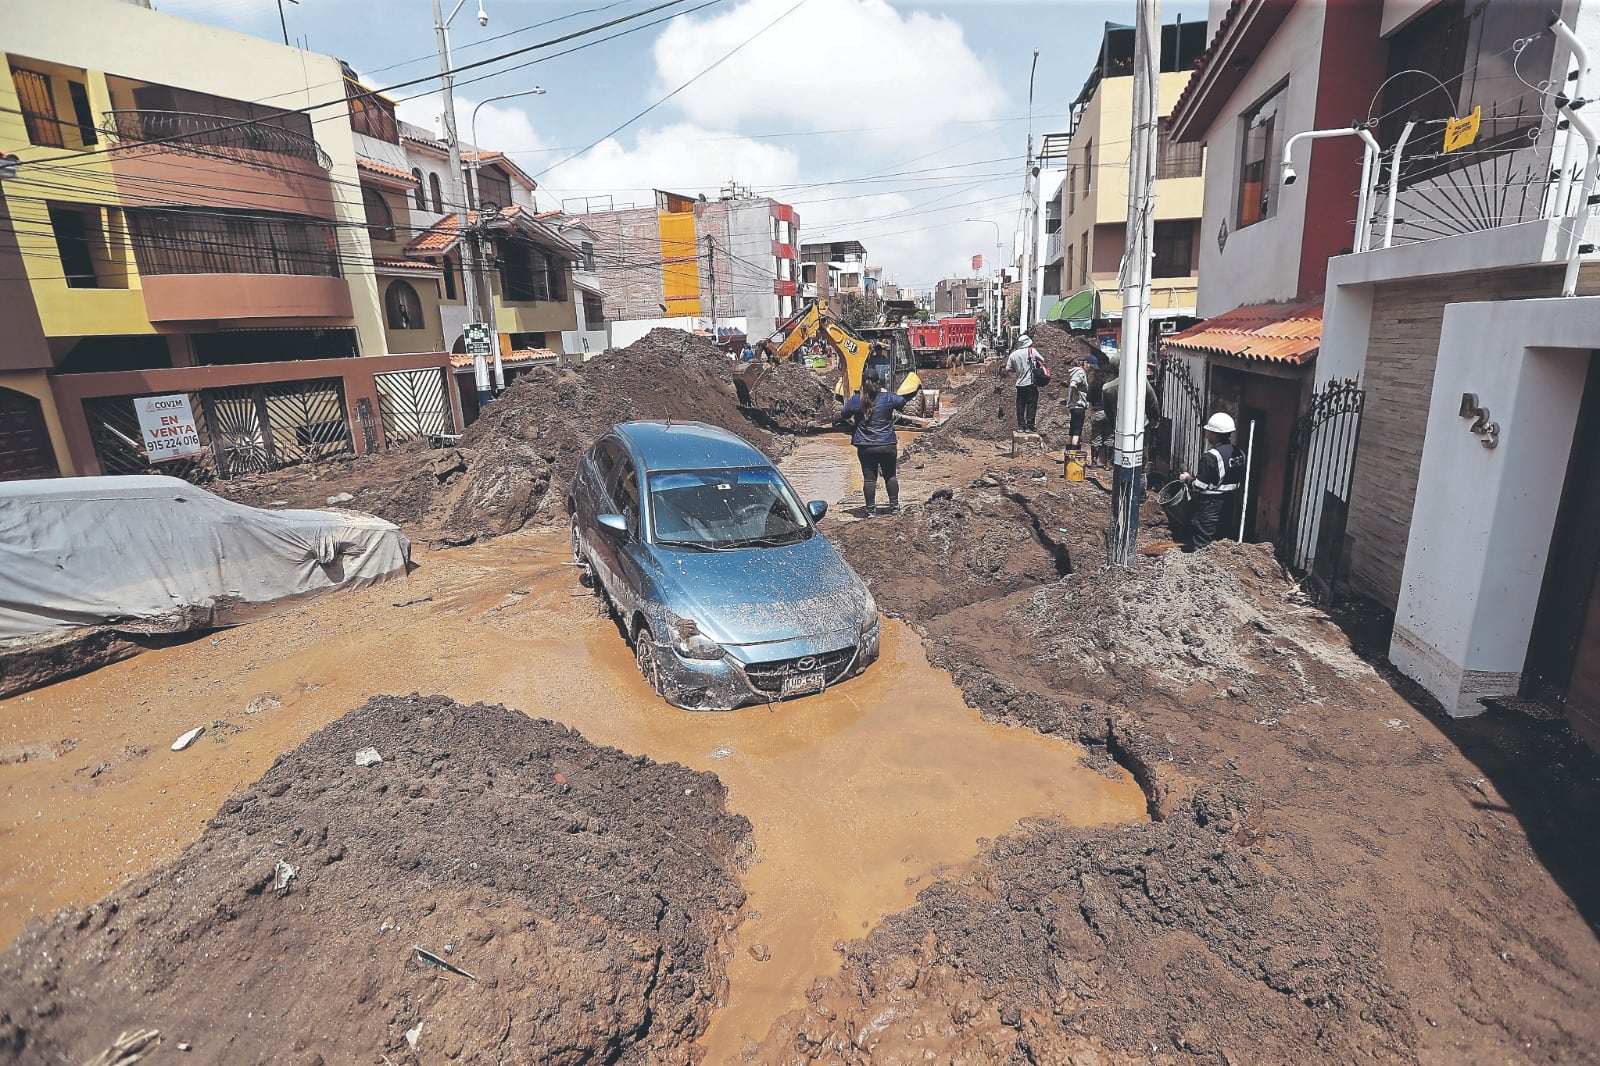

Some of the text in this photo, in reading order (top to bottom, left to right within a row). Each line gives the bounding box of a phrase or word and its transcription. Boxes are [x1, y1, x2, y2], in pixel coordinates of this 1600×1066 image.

[155, 399, 183, 409] COVIM
[160, 415, 179, 426] EN
[149, 424, 194, 439] VENTA
[147, 434, 199, 451] 915 224 016
